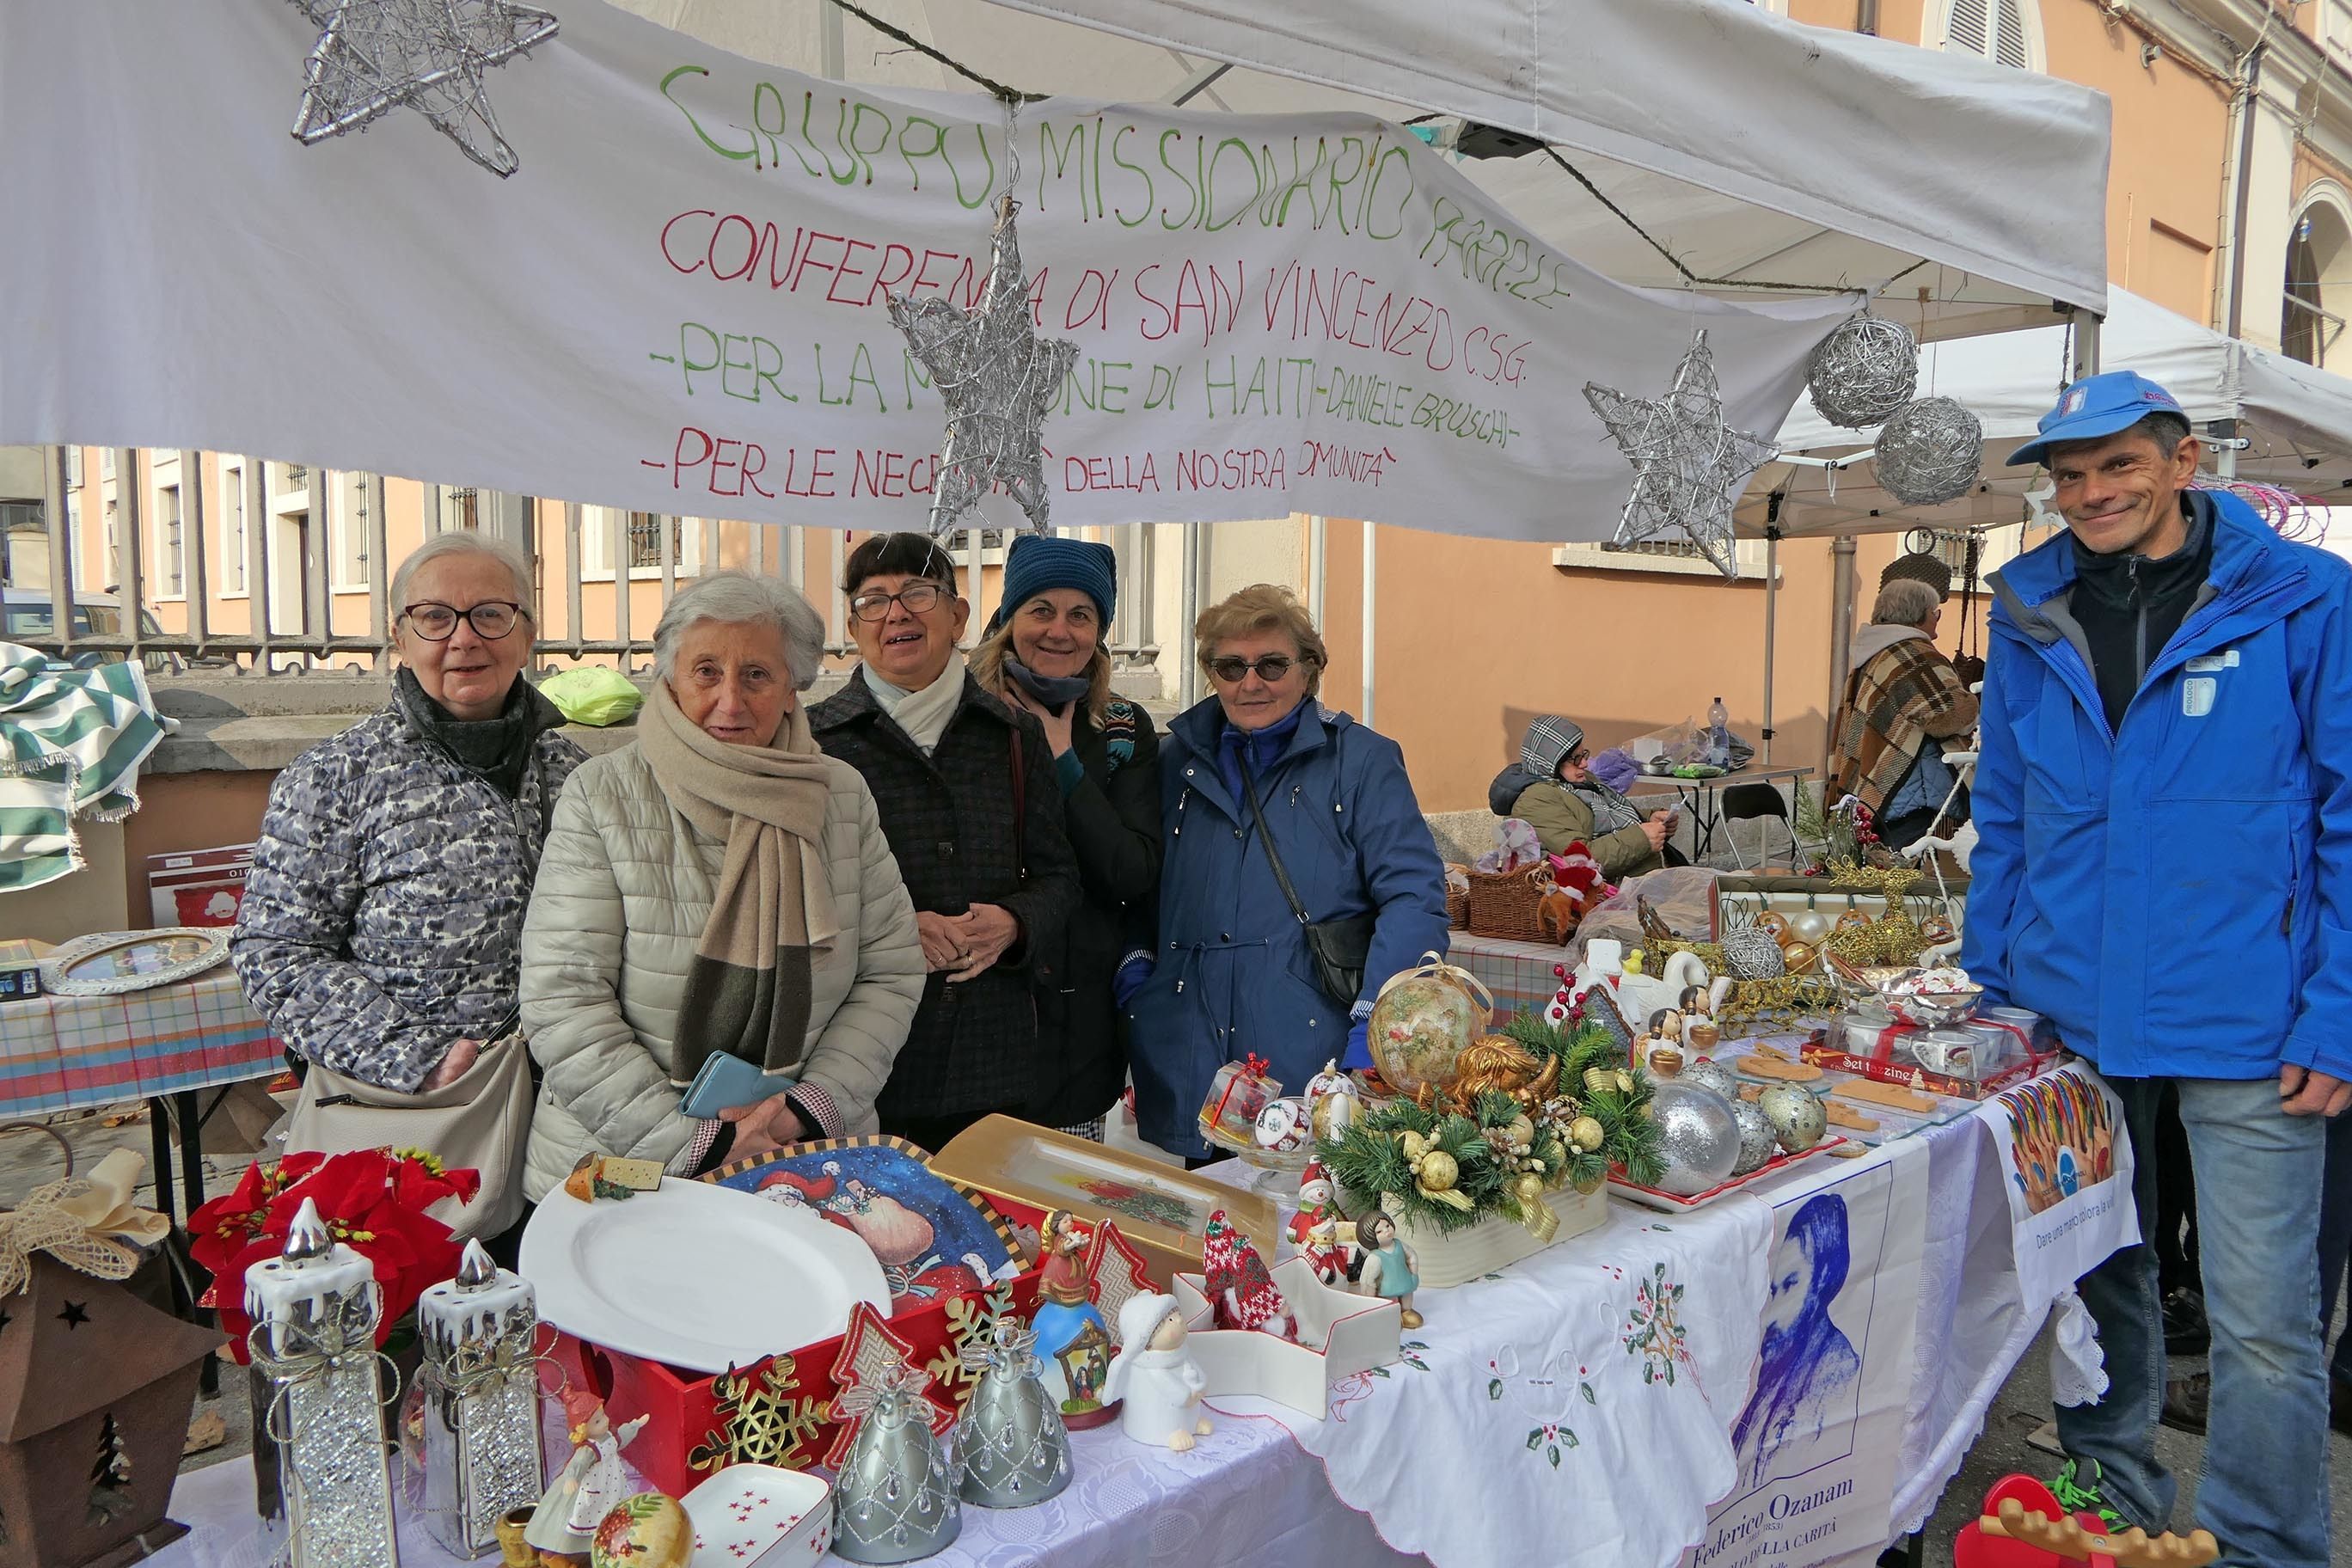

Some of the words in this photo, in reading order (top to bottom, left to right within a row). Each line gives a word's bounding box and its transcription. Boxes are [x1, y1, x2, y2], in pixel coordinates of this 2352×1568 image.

[660, 65, 994, 209] GRUPPO
[1039, 118, 1415, 240] MISSIONARIO
[661, 210, 1048, 327] CONFERENA
[1065, 268, 1118, 330] DI
[1135, 260, 1243, 347] SAN
[1265, 260, 1454, 371] VINCENZO
[814, 343, 887, 413] LA
[1143, 364, 1183, 410] DI
[785, 449, 836, 498] LE
[1065, 452, 1160, 492] DELLA
[1176, 448, 1286, 491] NOSTRA
[1297, 439, 1397, 487] OMUNITÀ
[1842, 1056, 1863, 1071] Set
[1865, 1060, 1913, 1081] tazzine
[2036, 1233, 2052, 1249] Dare
[1693, 1511, 1765, 1568] Federico
[1768, 1479, 1853, 1521] Ozanam
[1793, 1516, 1837, 1548] CARITÀ
